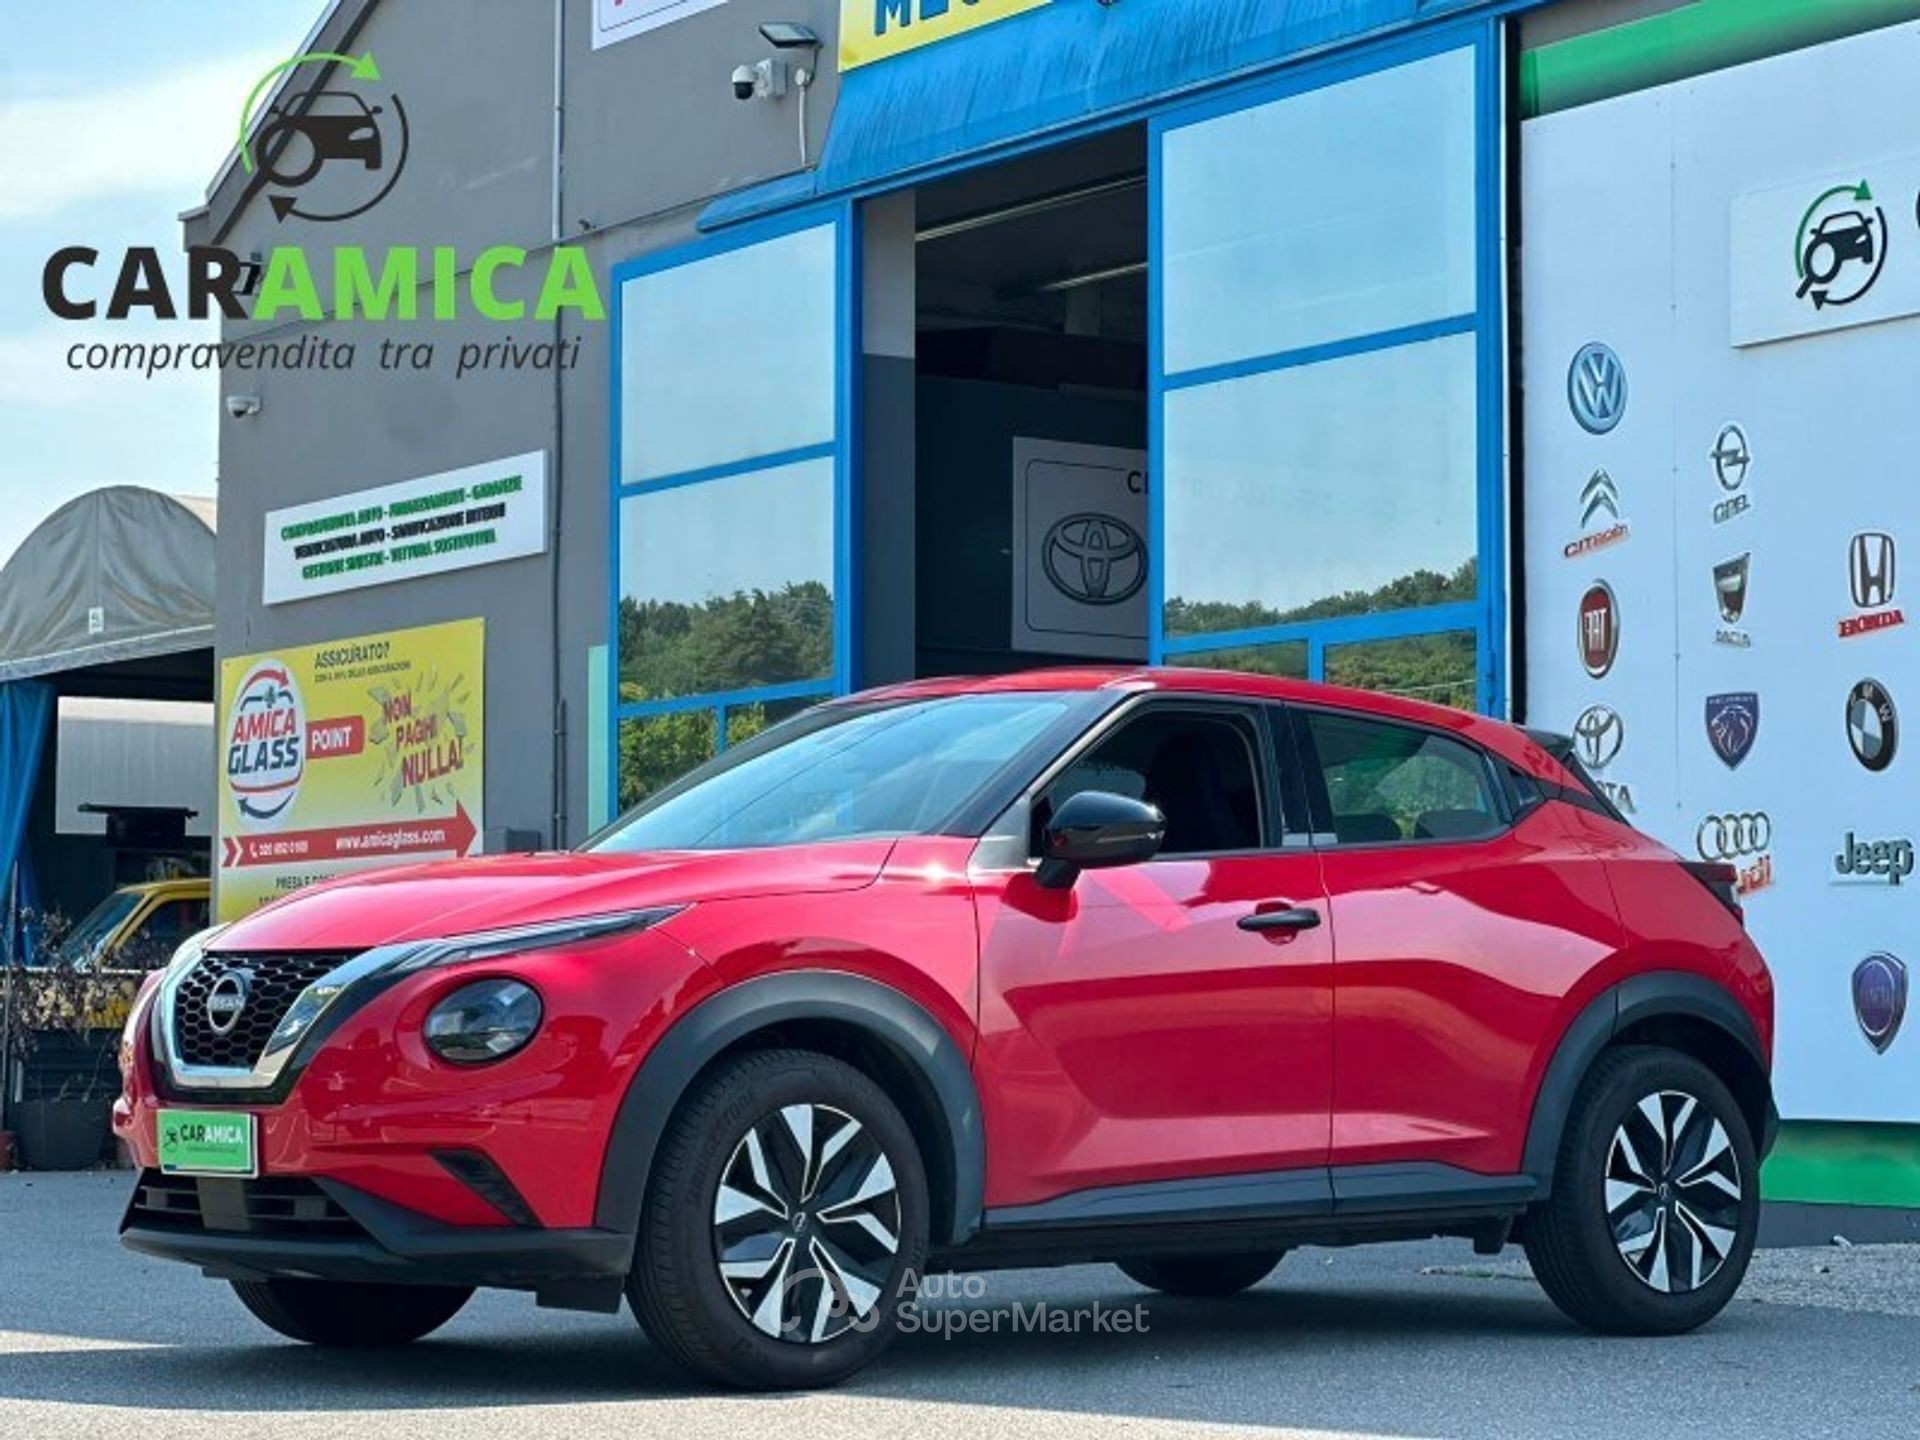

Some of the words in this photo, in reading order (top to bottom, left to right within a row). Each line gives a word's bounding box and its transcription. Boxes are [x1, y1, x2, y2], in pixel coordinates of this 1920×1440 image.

[232, 707, 296, 743] AMICA
[311, 725, 352, 751] POINT
[228, 736, 299, 775] GLASS
[1835, 832, 1914, 886] Jeep
[181, 1124, 244, 1144] CARAMICA
